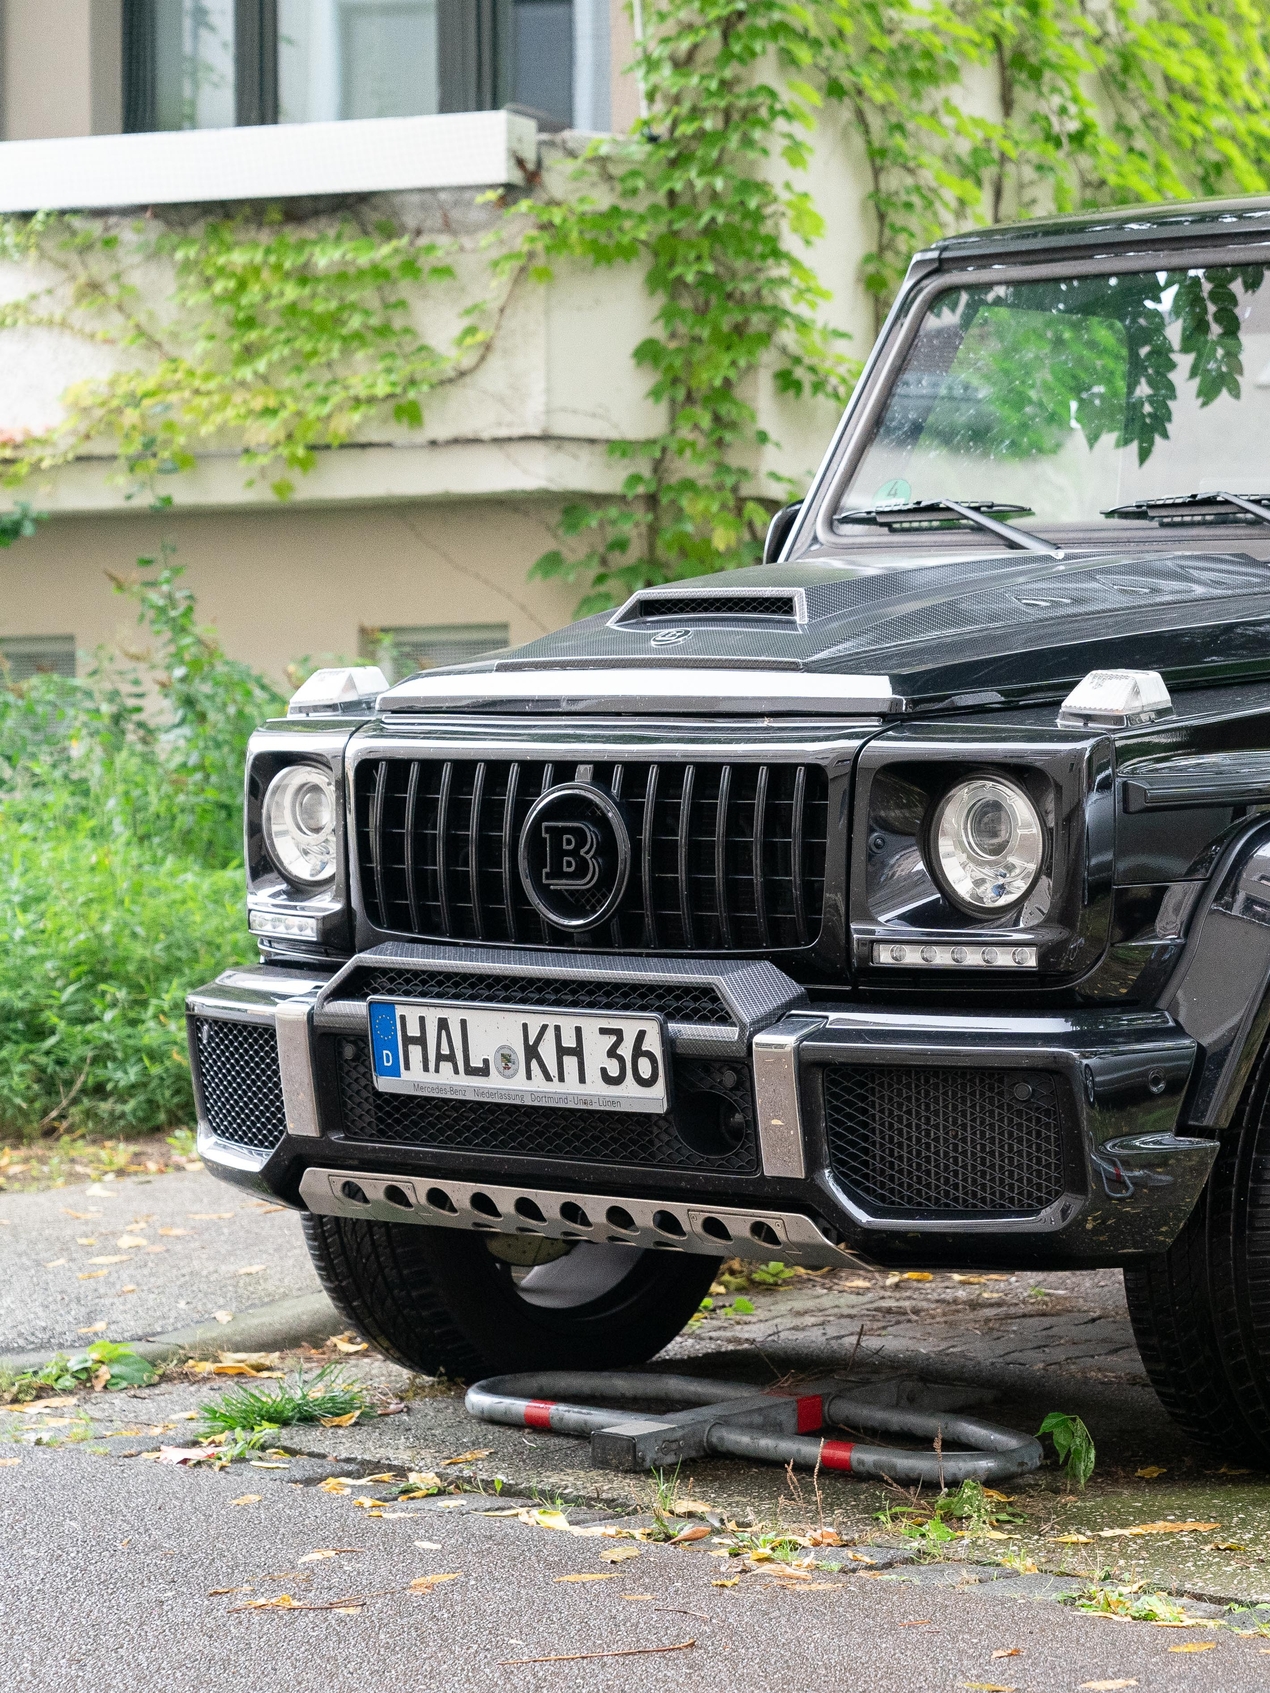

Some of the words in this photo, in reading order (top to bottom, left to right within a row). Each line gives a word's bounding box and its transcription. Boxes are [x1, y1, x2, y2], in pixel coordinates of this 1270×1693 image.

[886, 481, 898, 498] 4
[542, 822, 599, 889] B
[382, 1050, 393, 1067] D
[399, 1013, 490, 1077] HAL
[521, 1021, 587, 1084] KH
[598, 1026, 660, 1088] 36
[413, 1083, 467, 1097] Mercedes-Benz
[473, 1089, 525, 1103] Niederlassung
